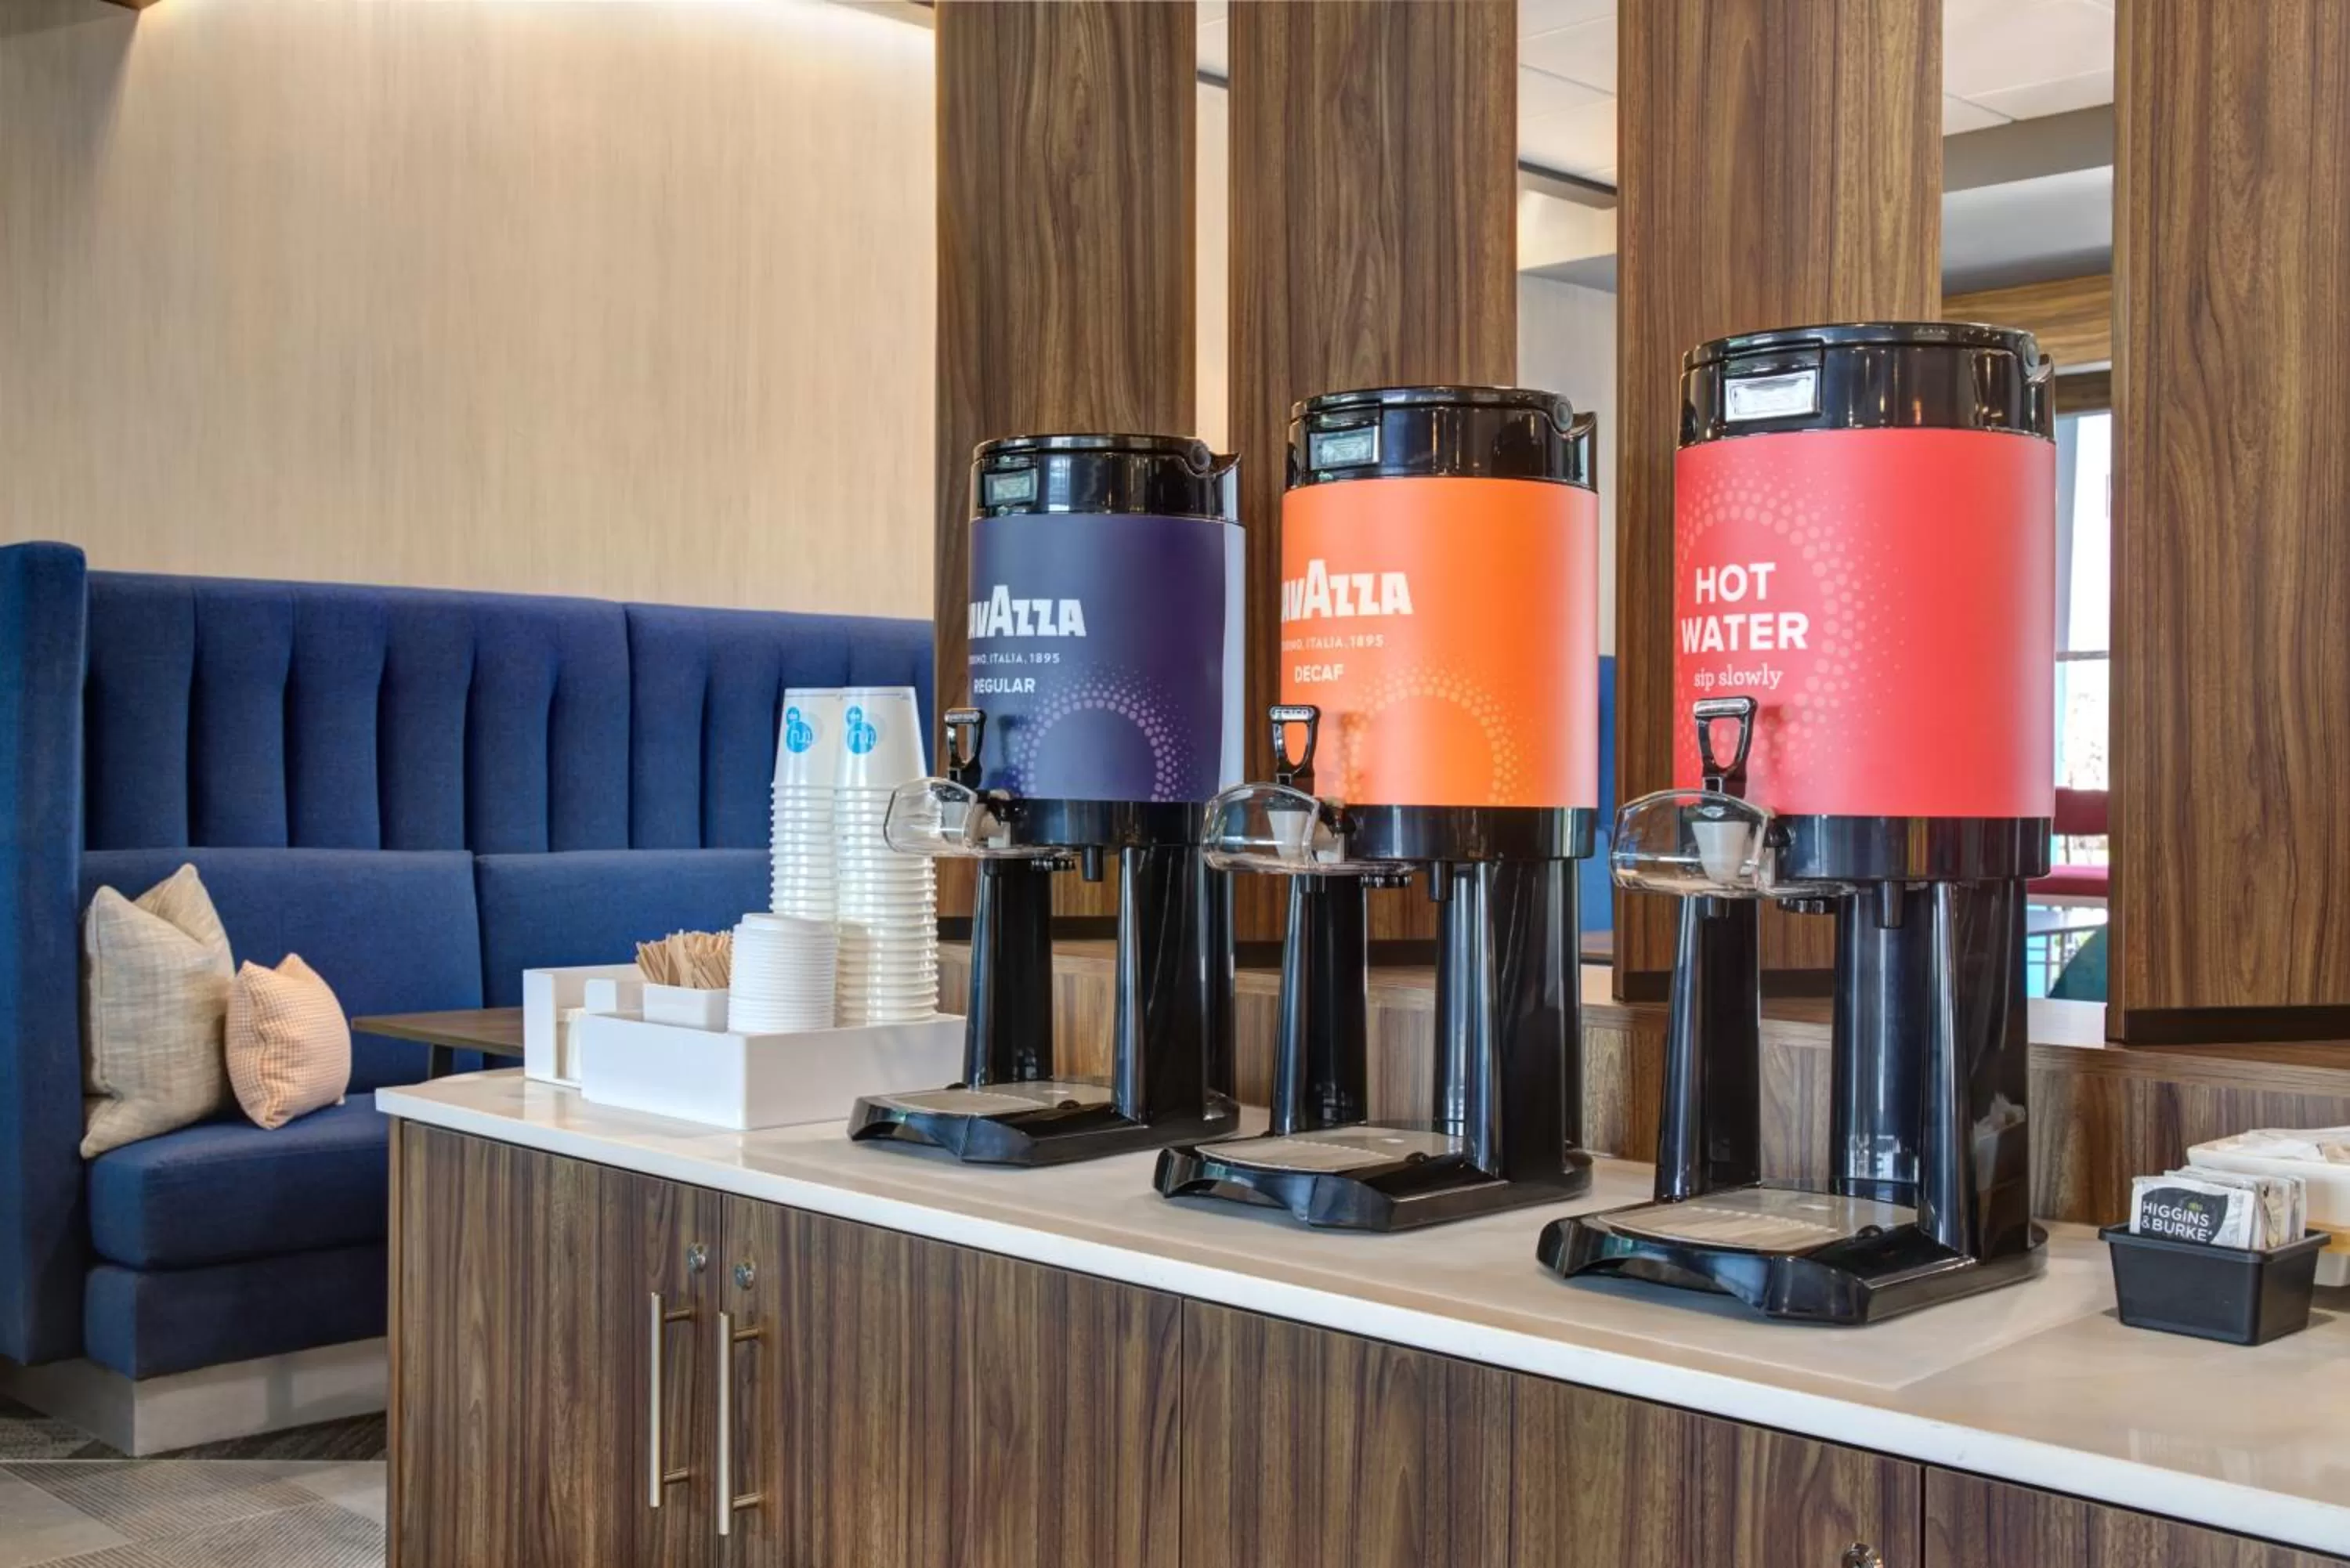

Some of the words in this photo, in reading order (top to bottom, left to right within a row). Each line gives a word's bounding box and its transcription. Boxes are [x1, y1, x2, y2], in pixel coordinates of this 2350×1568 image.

[1695, 562, 1776, 605] HOT
[1681, 612, 1810, 655] WATER
[1030, 652, 1060, 664] 1895
[974, 677, 1036, 694] REGULAR
[1294, 663, 1344, 683] DECAF
[1694, 667, 1715, 692] sip
[1719, 662, 1784, 689] slowly
[2142, 1201, 2210, 1227] HIGGINS
